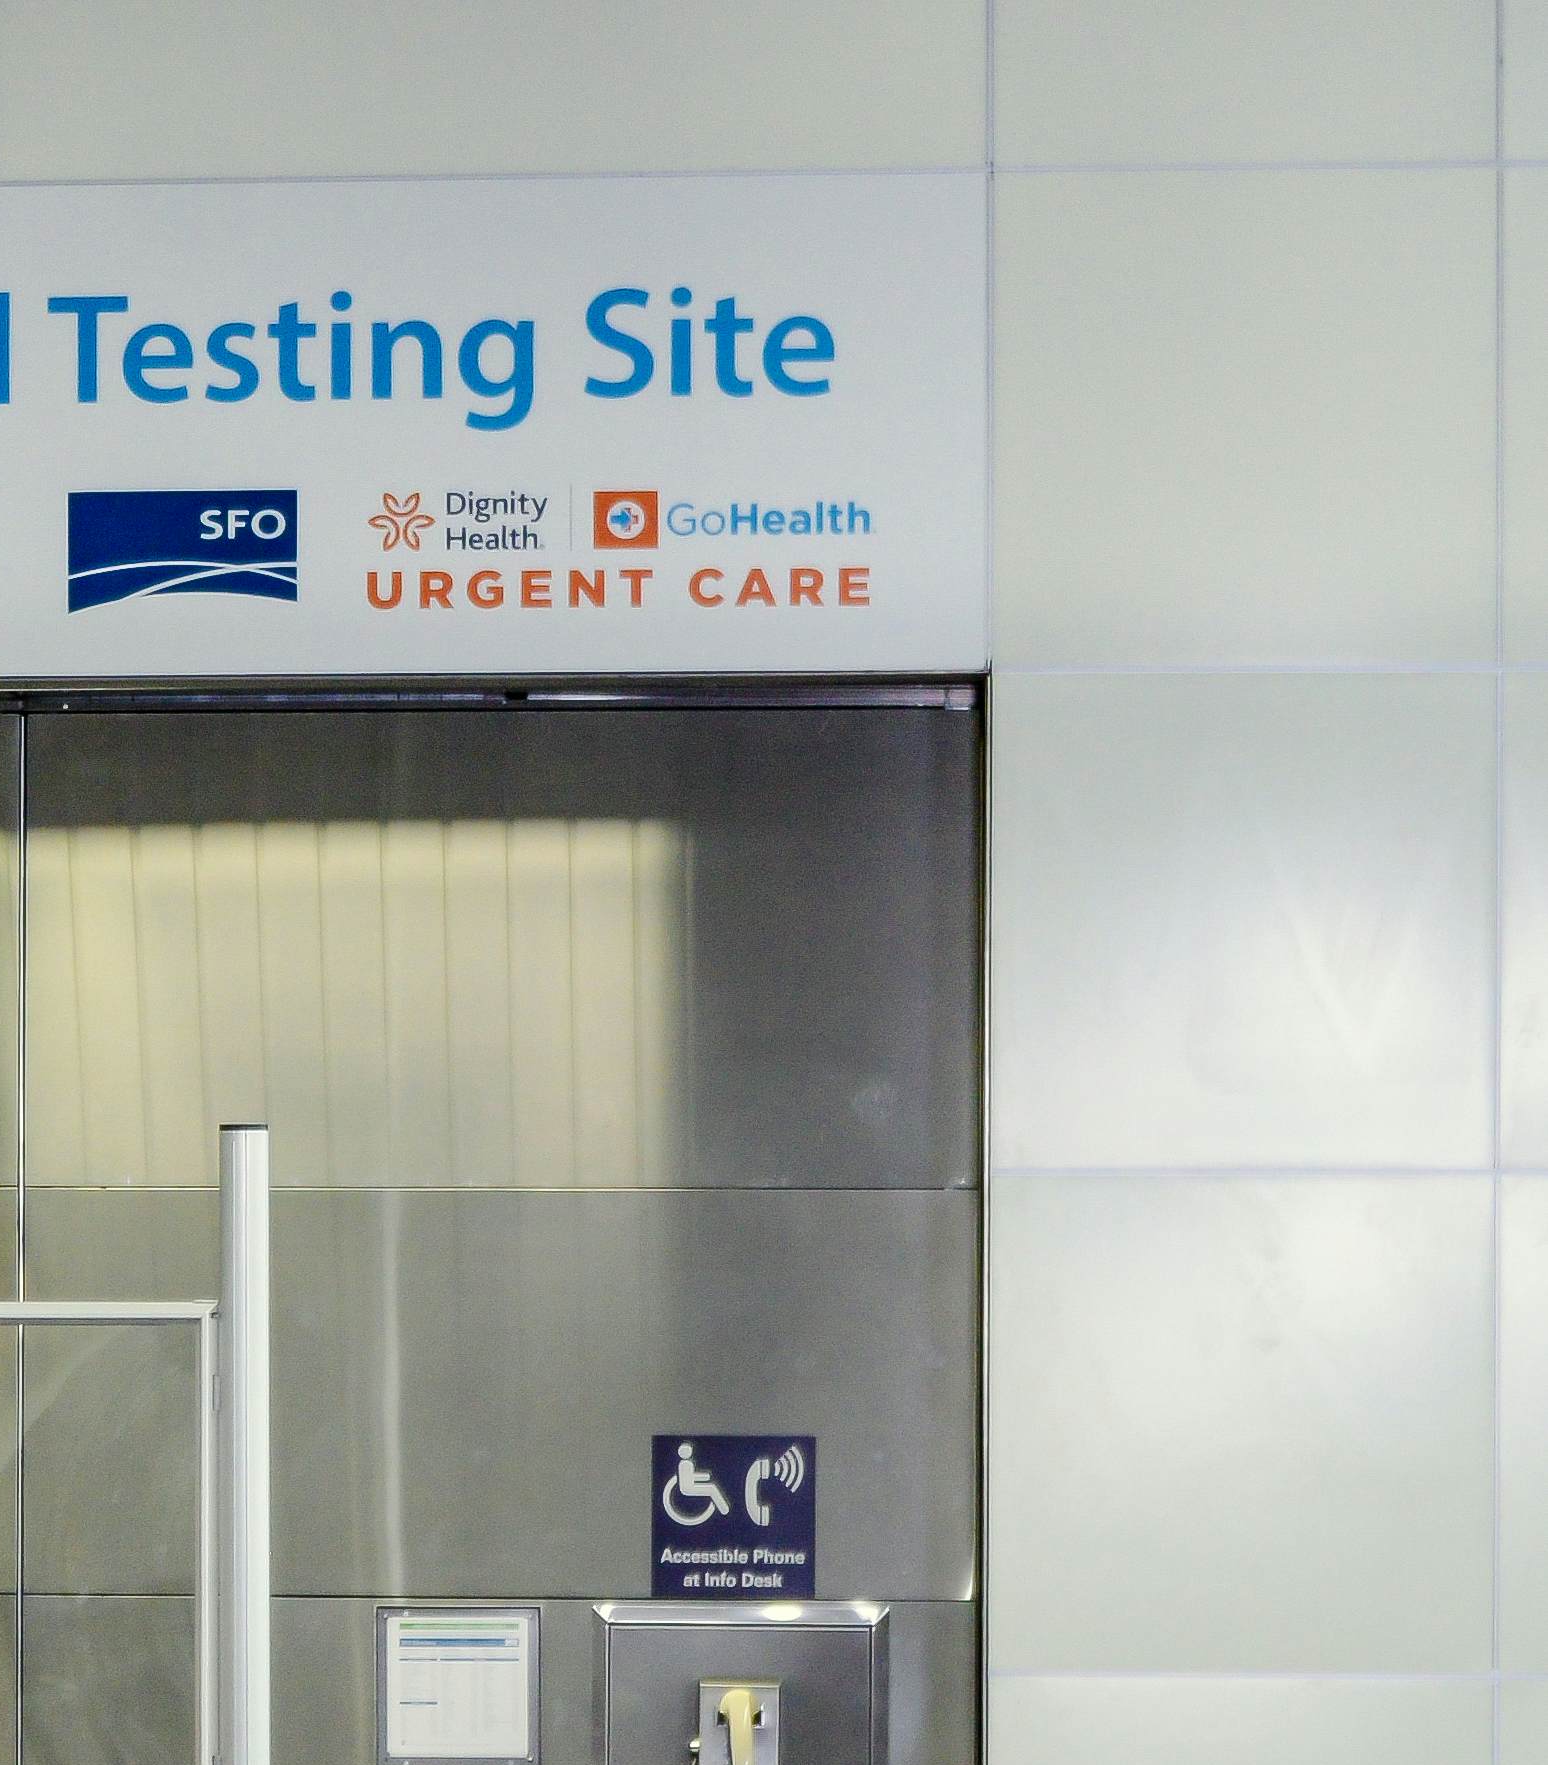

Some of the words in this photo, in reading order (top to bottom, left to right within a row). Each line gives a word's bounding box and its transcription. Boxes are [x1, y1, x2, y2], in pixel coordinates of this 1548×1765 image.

[47, 290, 536, 431] Testing
[585, 286, 836, 399] Site
[446, 491, 548, 523] Dignity
[667, 500, 871, 536] GoHealth
[200, 510, 285, 539] SFO
[446, 525, 539, 550] Health
[367, 568, 652, 608] URGENT
[690, 567, 868, 606] CARE
[660, 1547, 748, 1564] Accessible
[753, 1548, 806, 1564] Phone
[683, 1574, 700, 1587] at
[705, 1572, 736, 1587] Info
[742, 1573, 782, 1587] Desk
